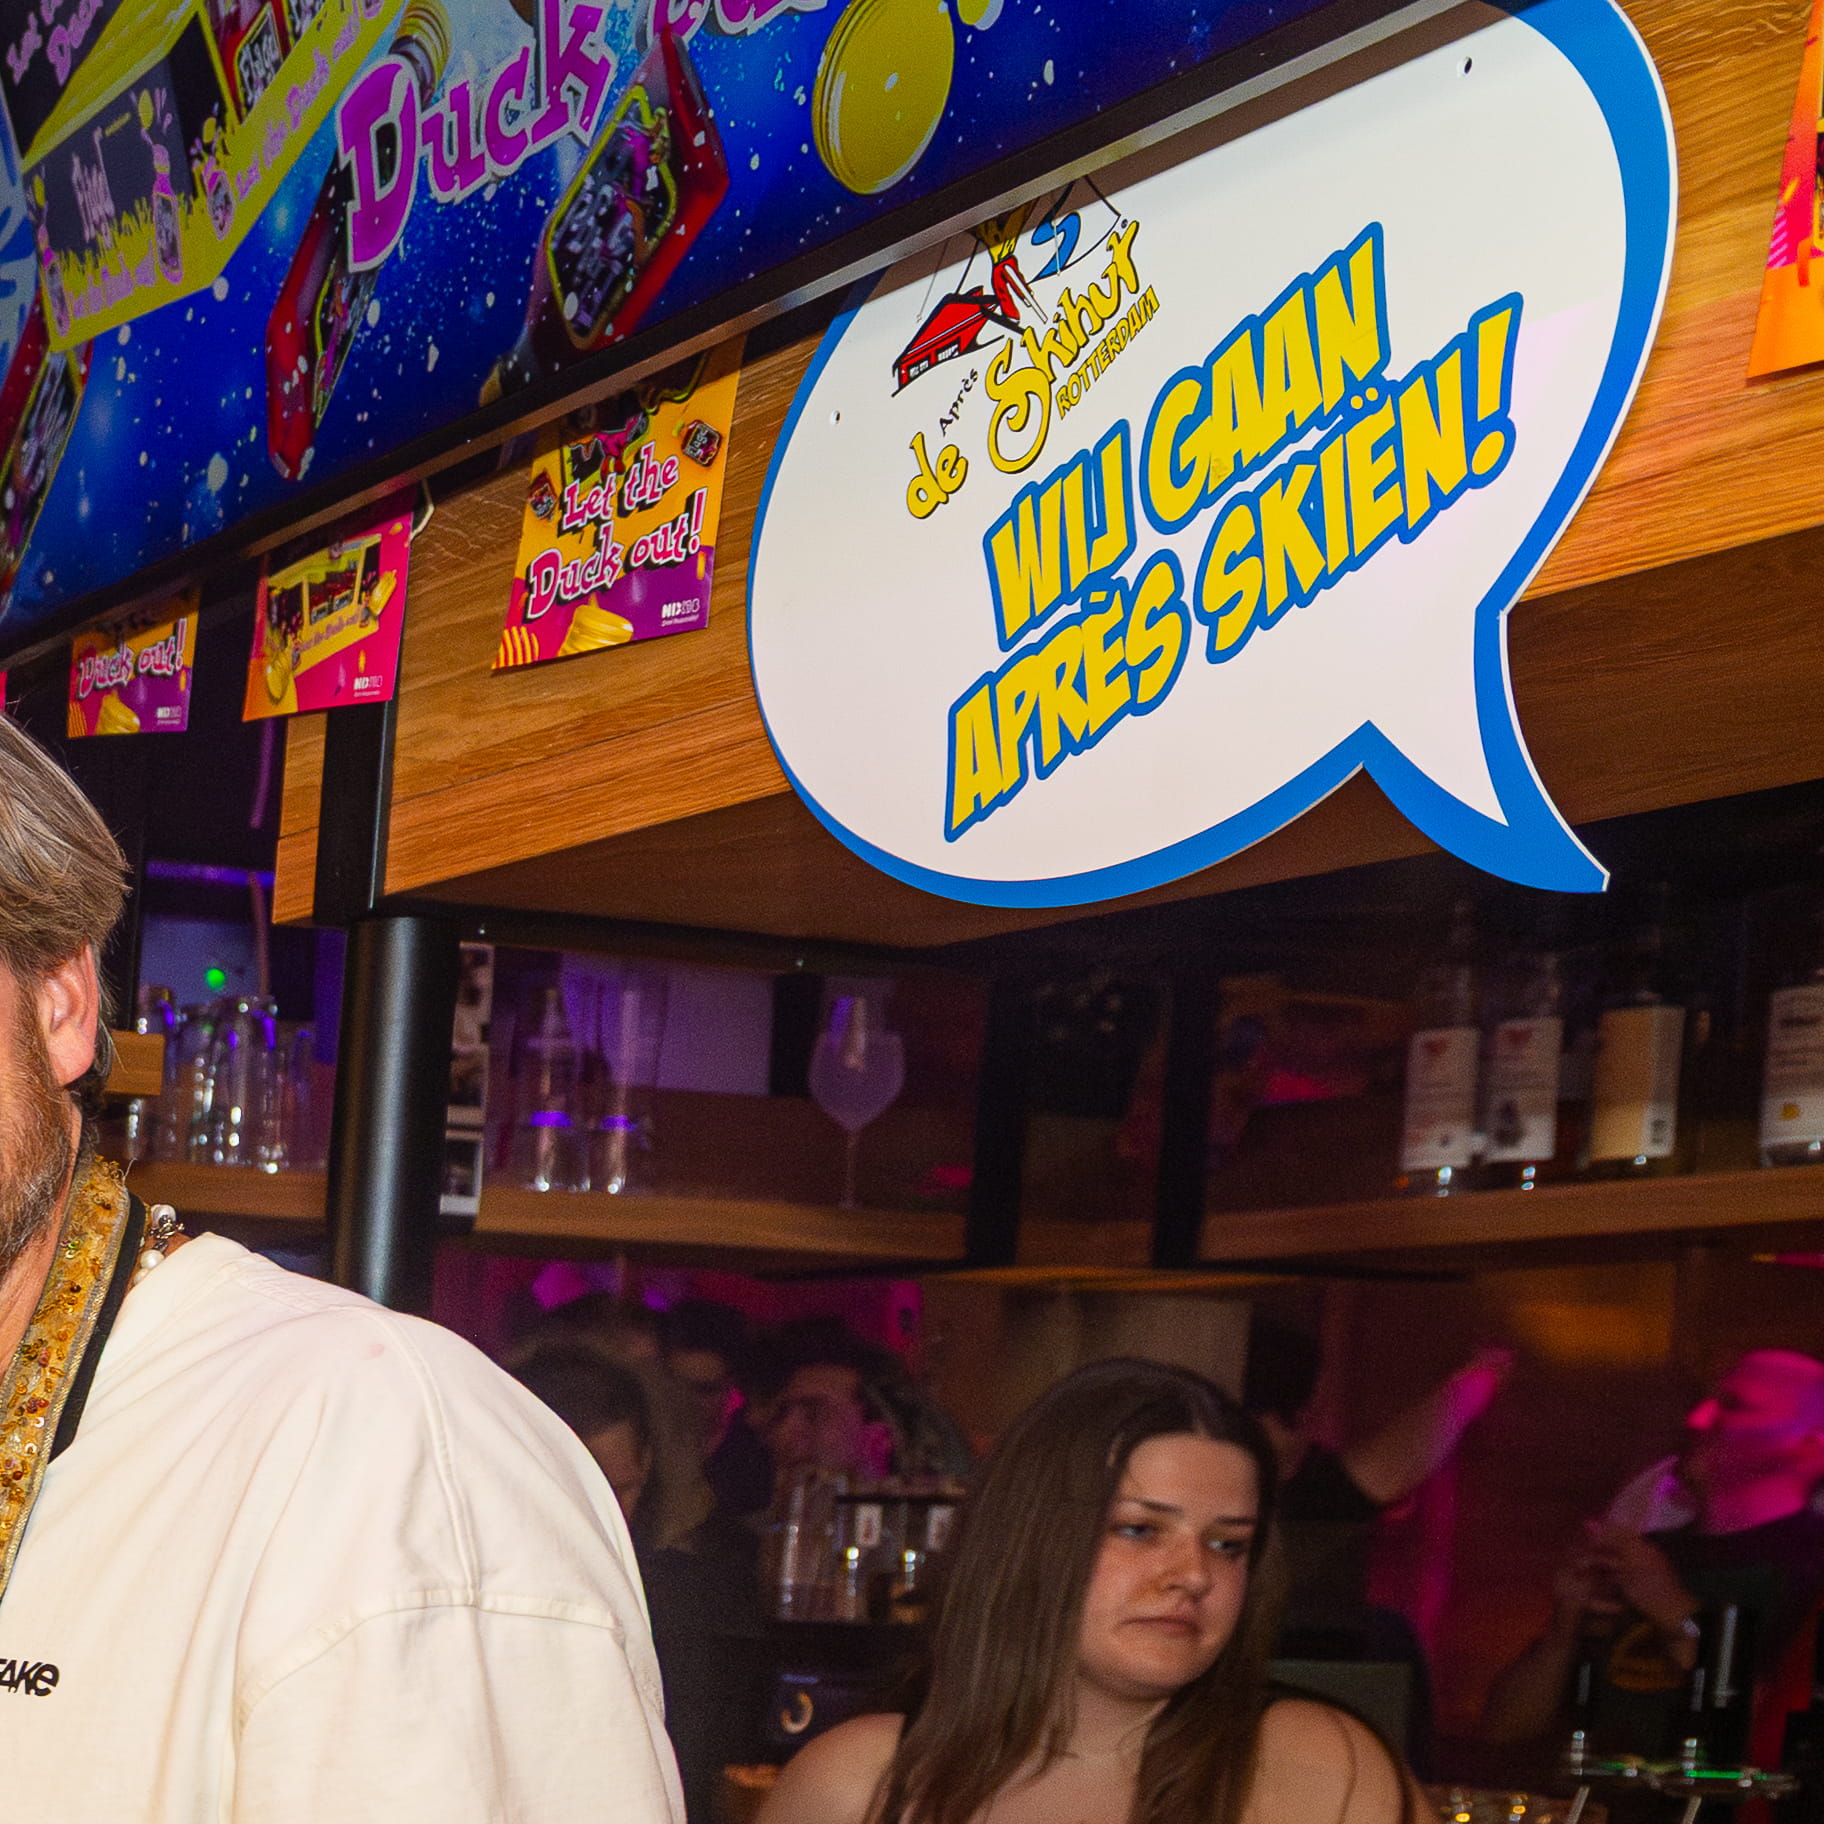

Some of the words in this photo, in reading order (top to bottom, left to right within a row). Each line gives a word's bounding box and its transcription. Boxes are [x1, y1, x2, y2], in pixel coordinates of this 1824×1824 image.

[1055, 284, 1161, 420] ROTTERDAM
[562, 472, 616, 530] Let
[624, 441, 680, 510] the
[906, 431, 968, 519] de
[939, 368, 979, 437] Après
[983, 418, 1136, 653] WIJ
[1140, 221, 1389, 536] GAAN
[1194, 291, 1524, 664] SKIËN!
[527, 520, 624, 619] Duck
[630, 487, 708, 566] out!
